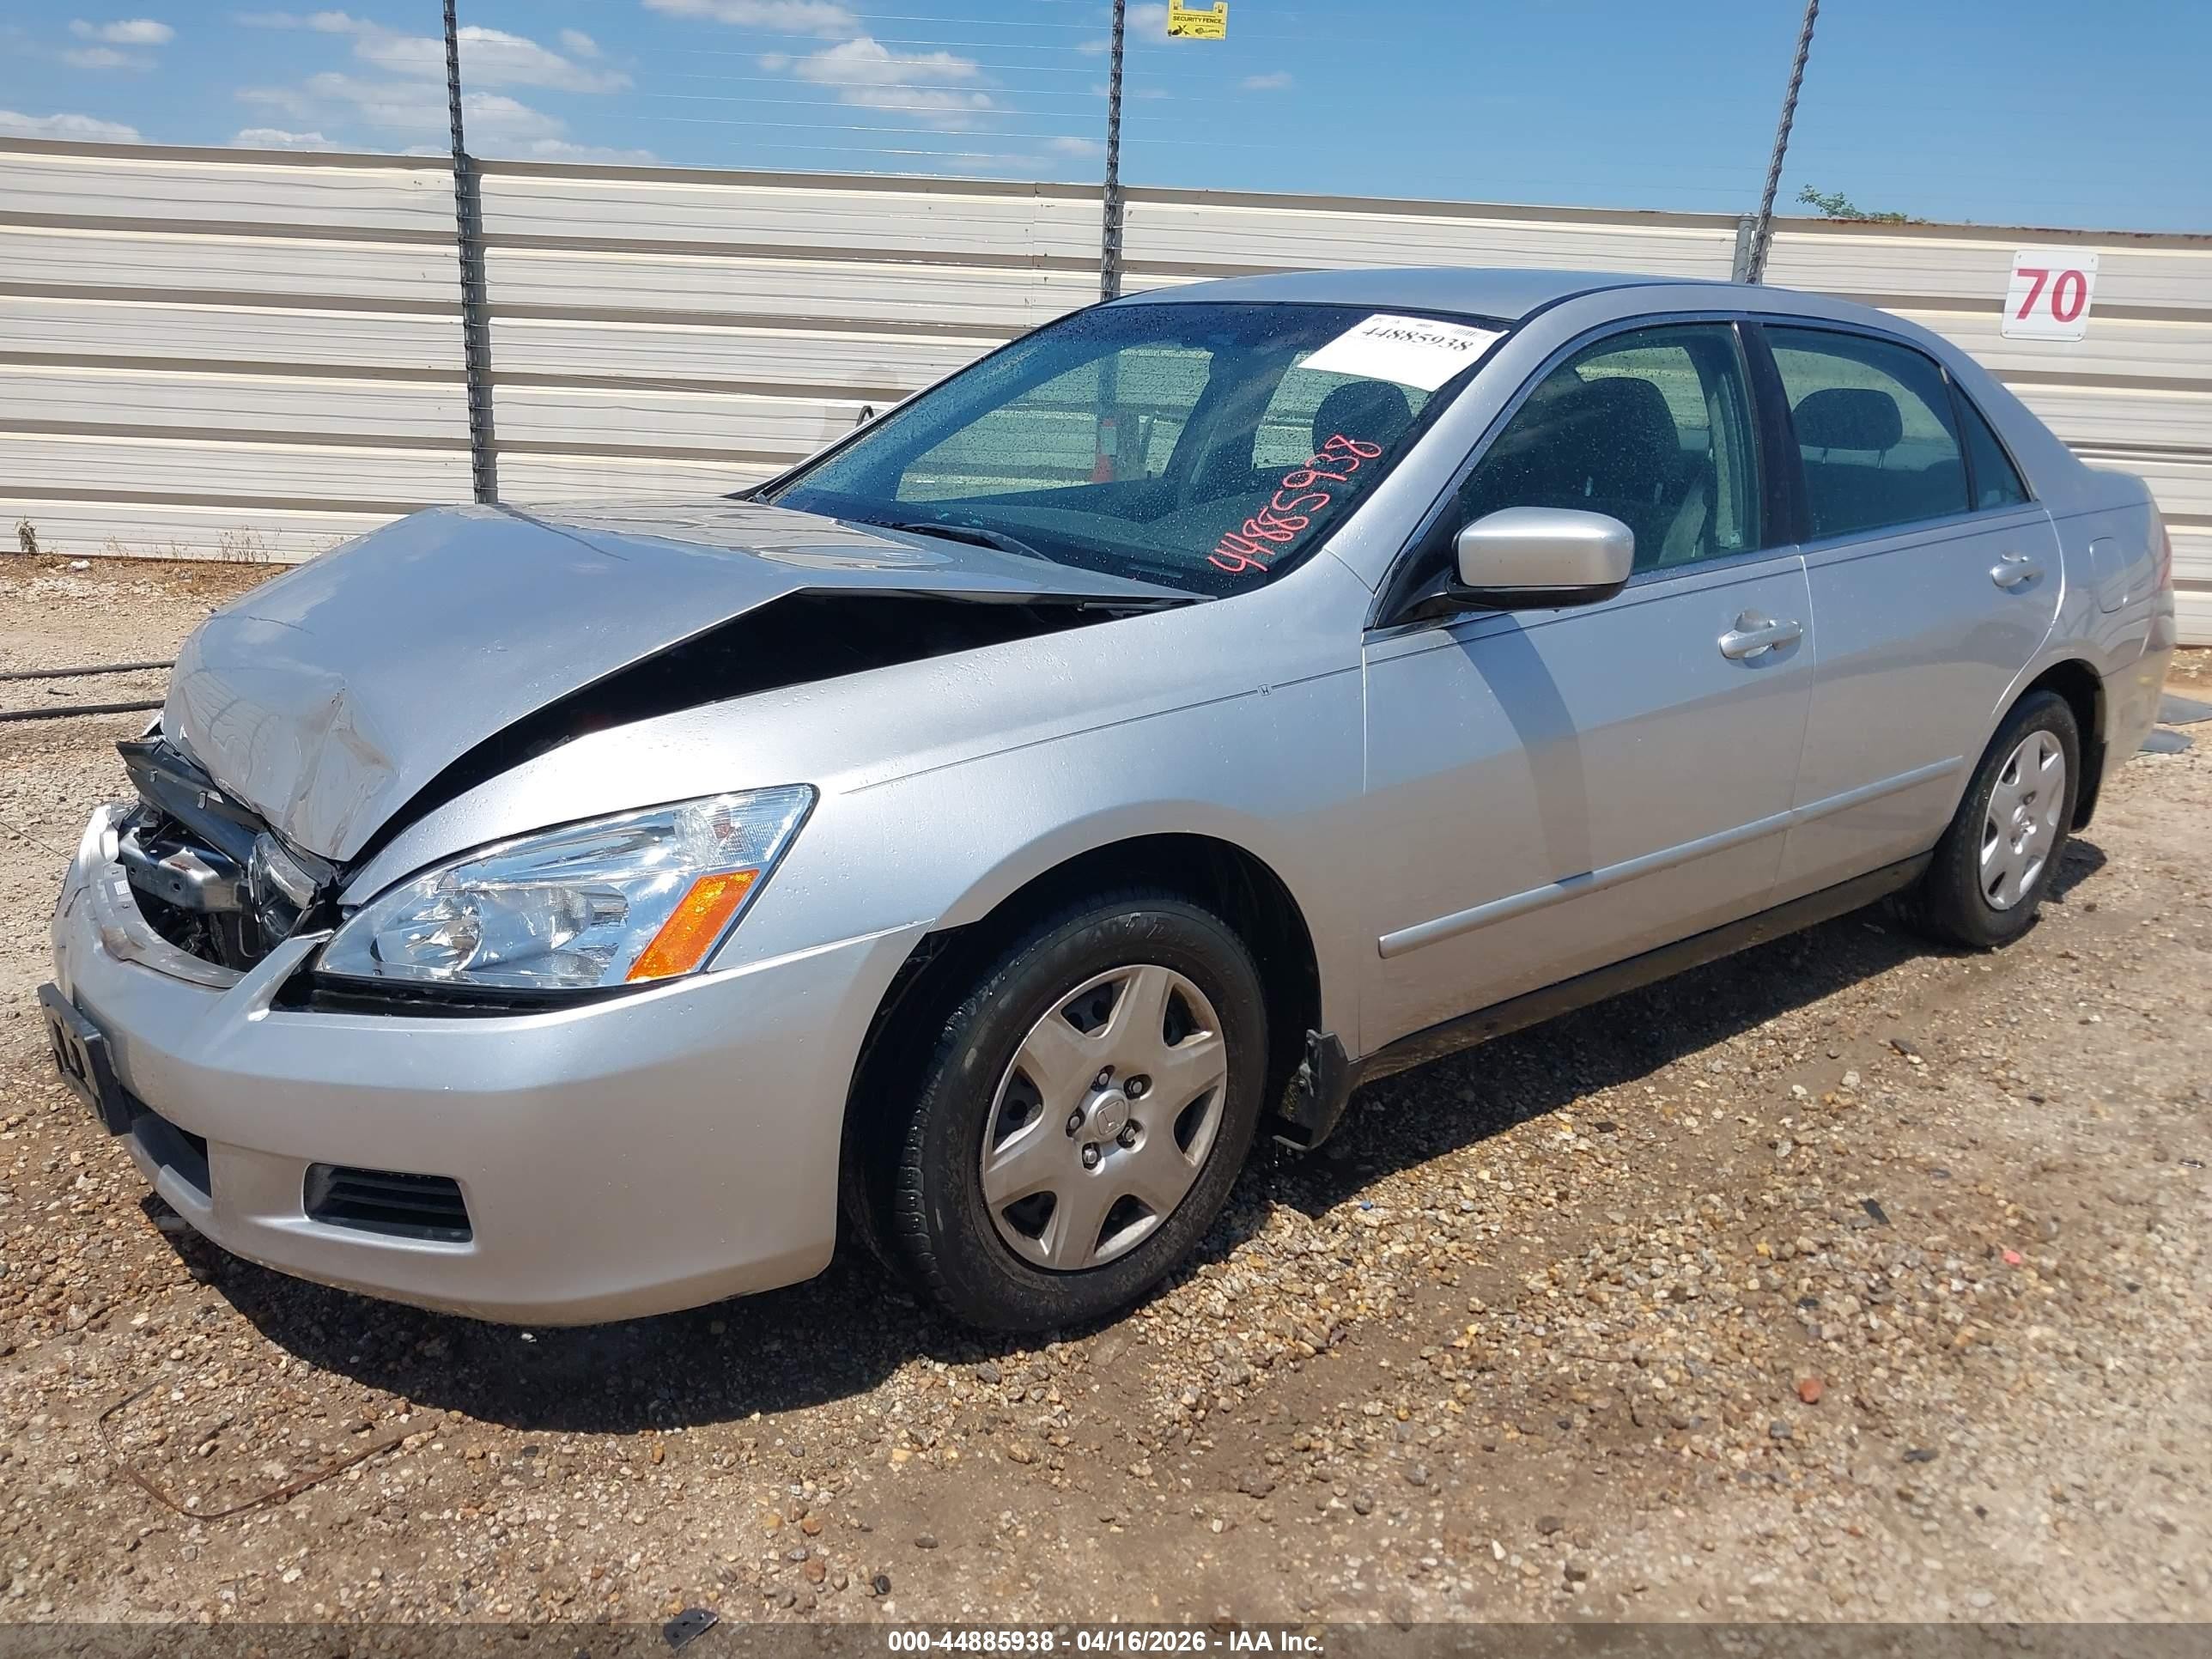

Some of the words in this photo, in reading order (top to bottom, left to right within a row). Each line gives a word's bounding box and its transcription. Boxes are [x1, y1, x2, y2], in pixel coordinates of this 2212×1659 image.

[2015, 268, 2087, 323] 70
[1362, 327, 1474, 351] 44885938
[1207, 434, 1382, 574] 44885938
